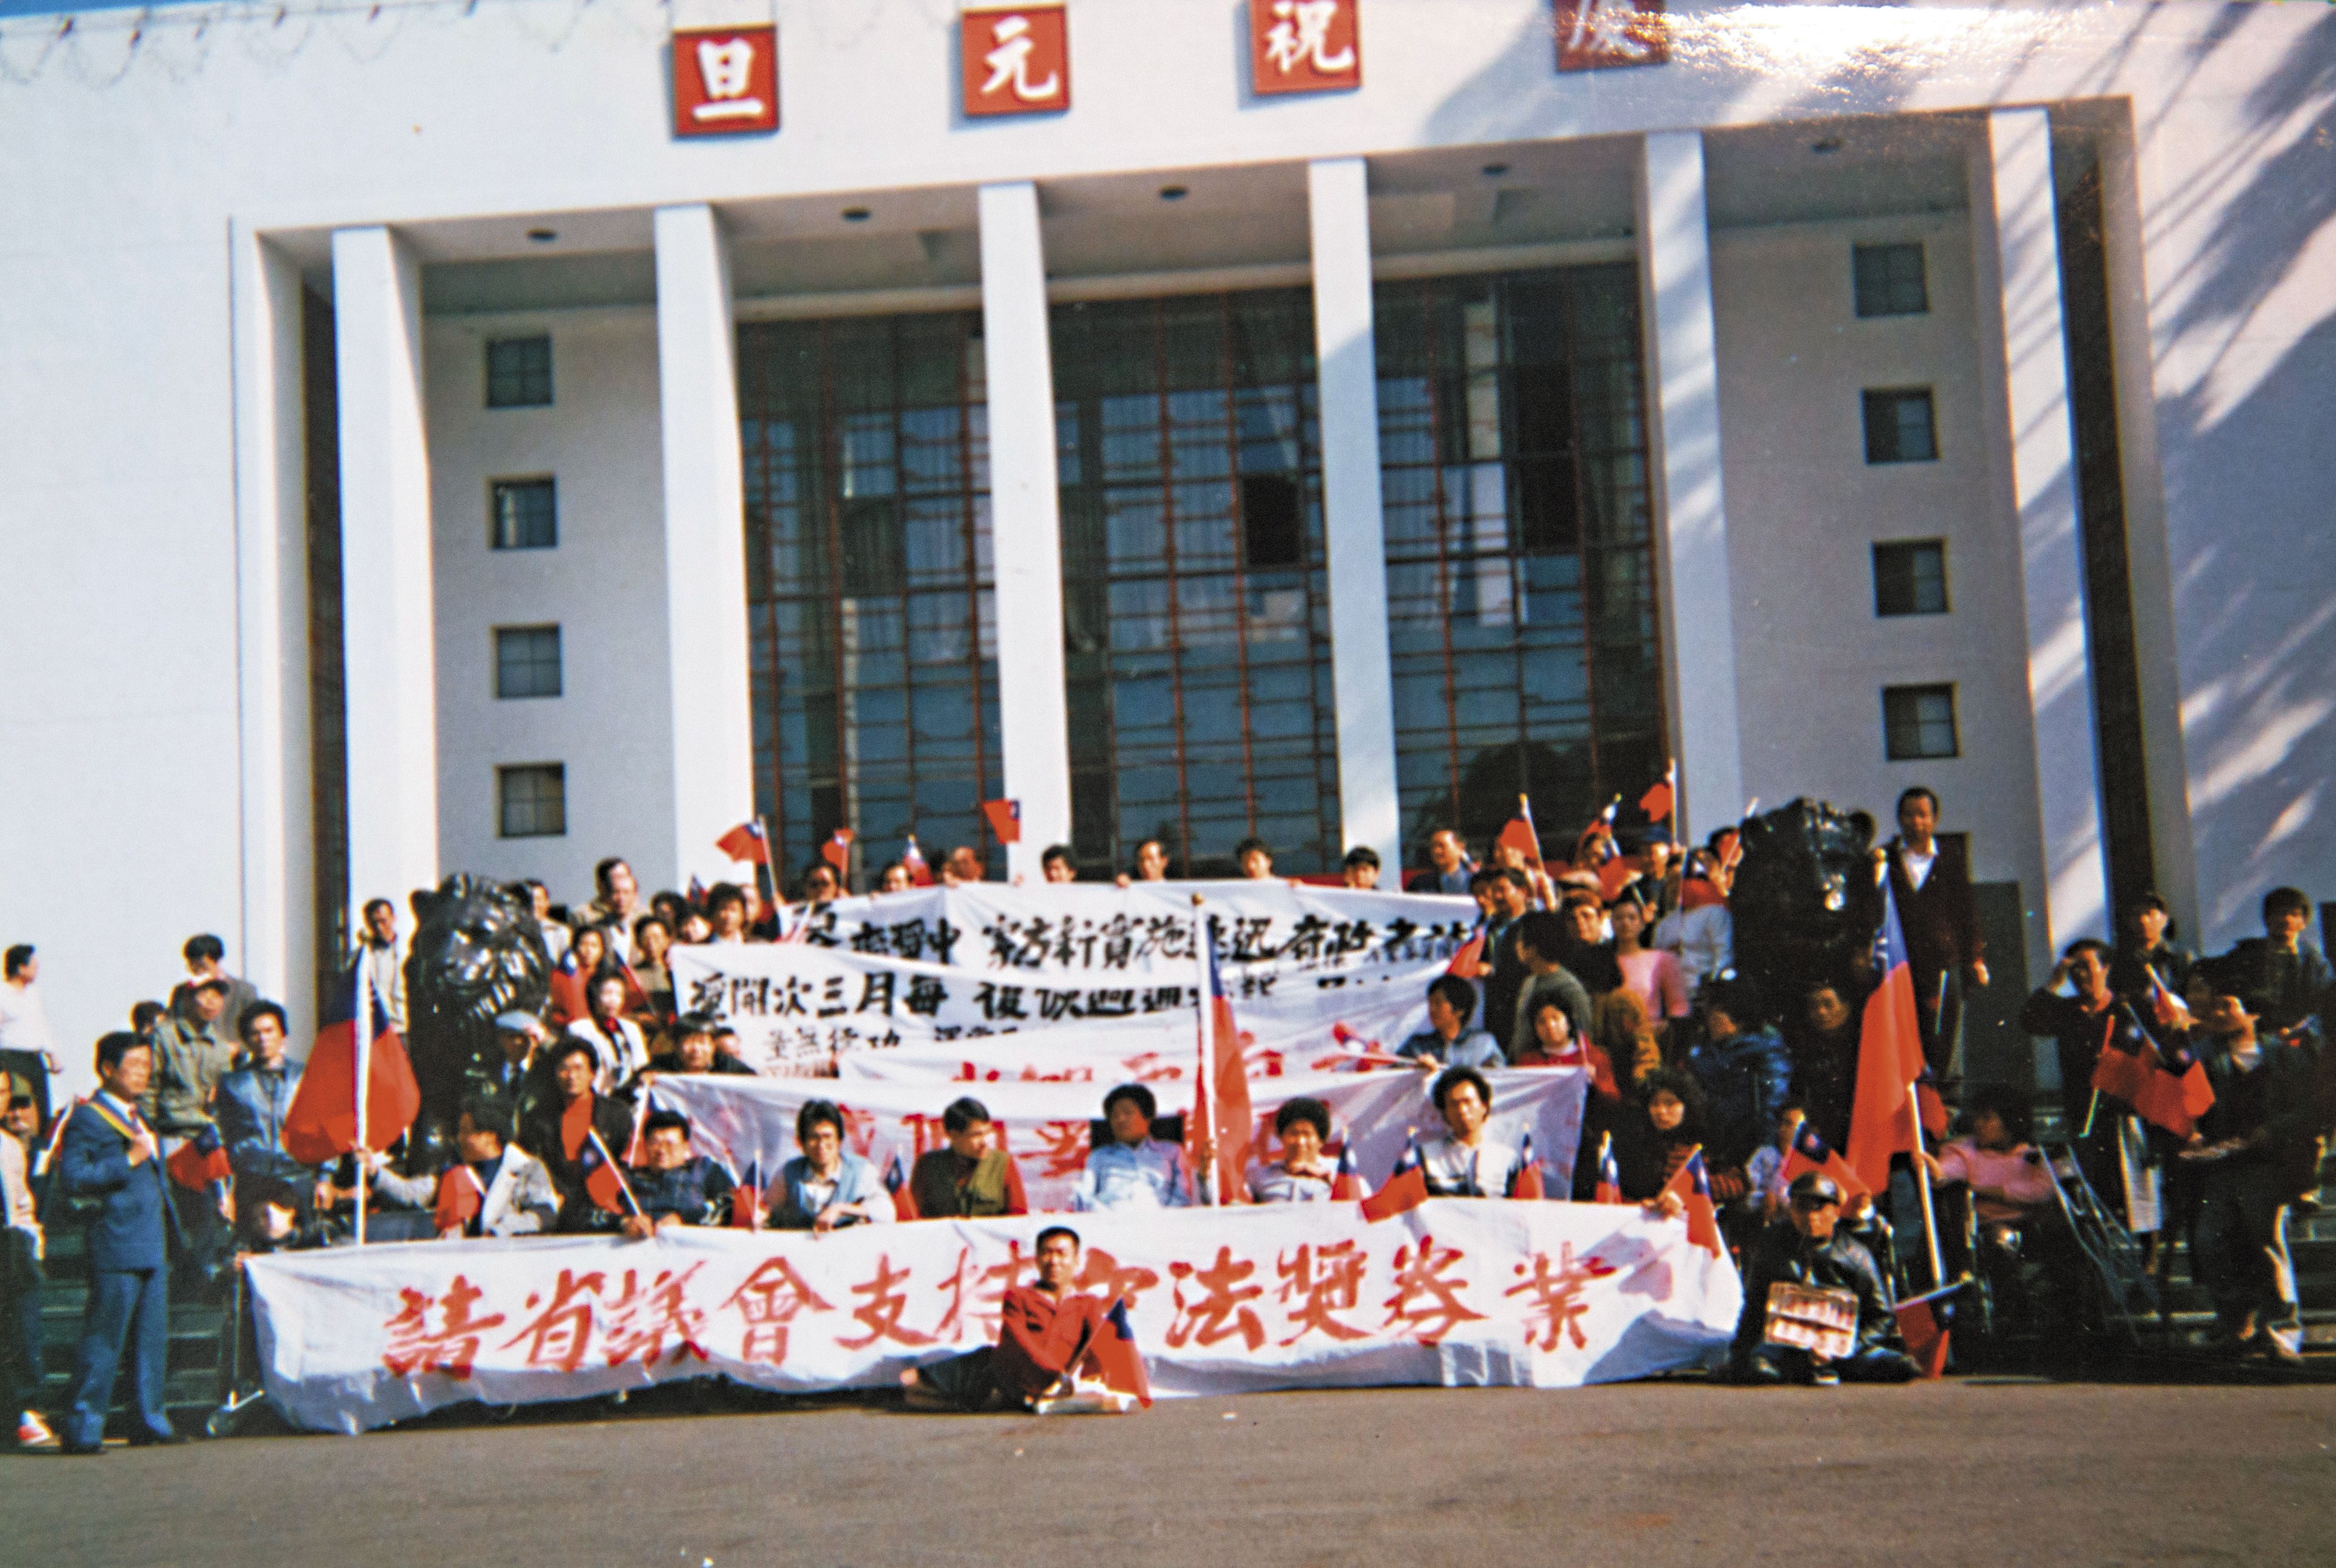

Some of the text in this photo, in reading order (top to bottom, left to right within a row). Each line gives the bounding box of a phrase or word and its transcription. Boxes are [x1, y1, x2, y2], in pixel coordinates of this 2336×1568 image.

[980, 15, 1058, 100] 元
[1264, 0, 1356, 74] 祝
[693, 38, 764, 121] 旦
